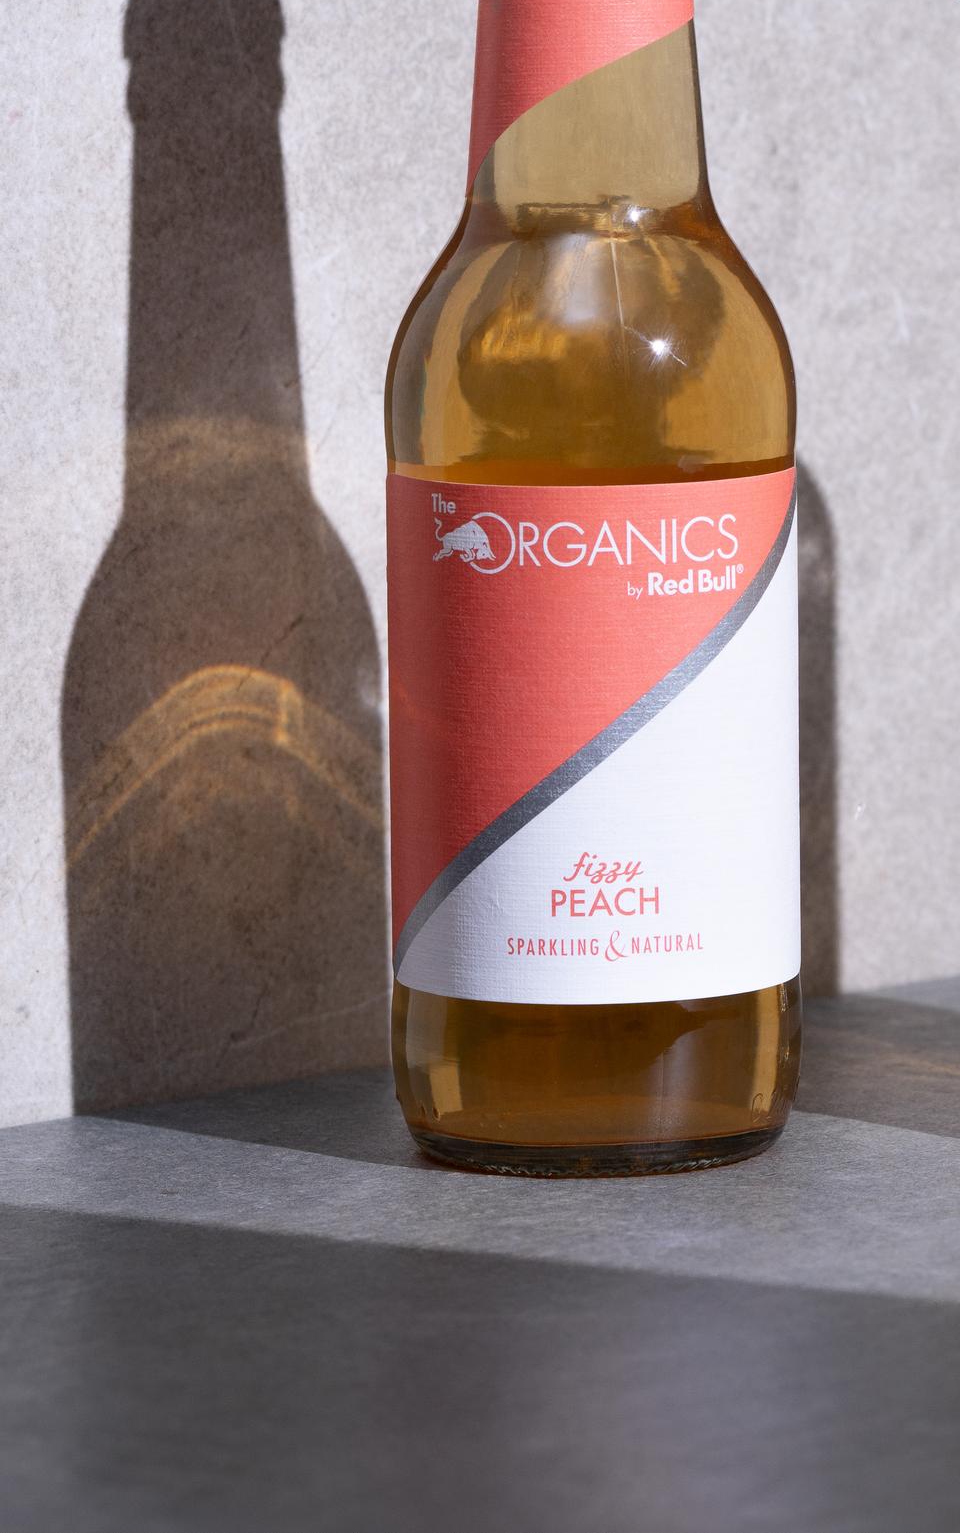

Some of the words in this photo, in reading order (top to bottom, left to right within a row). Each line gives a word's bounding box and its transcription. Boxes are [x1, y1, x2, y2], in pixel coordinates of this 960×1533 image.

[431, 493, 457, 514] The
[469, 511, 738, 575] ORGANICS
[627, 581, 643, 600] by
[647, 569, 694, 596] Red
[563, 851, 645, 884] fizzy
[551, 887, 659, 917] PEACH
[507, 937, 599, 957] SPARKLING
[604, 930, 629, 963] &
[631, 932, 704, 955] NATURAL
